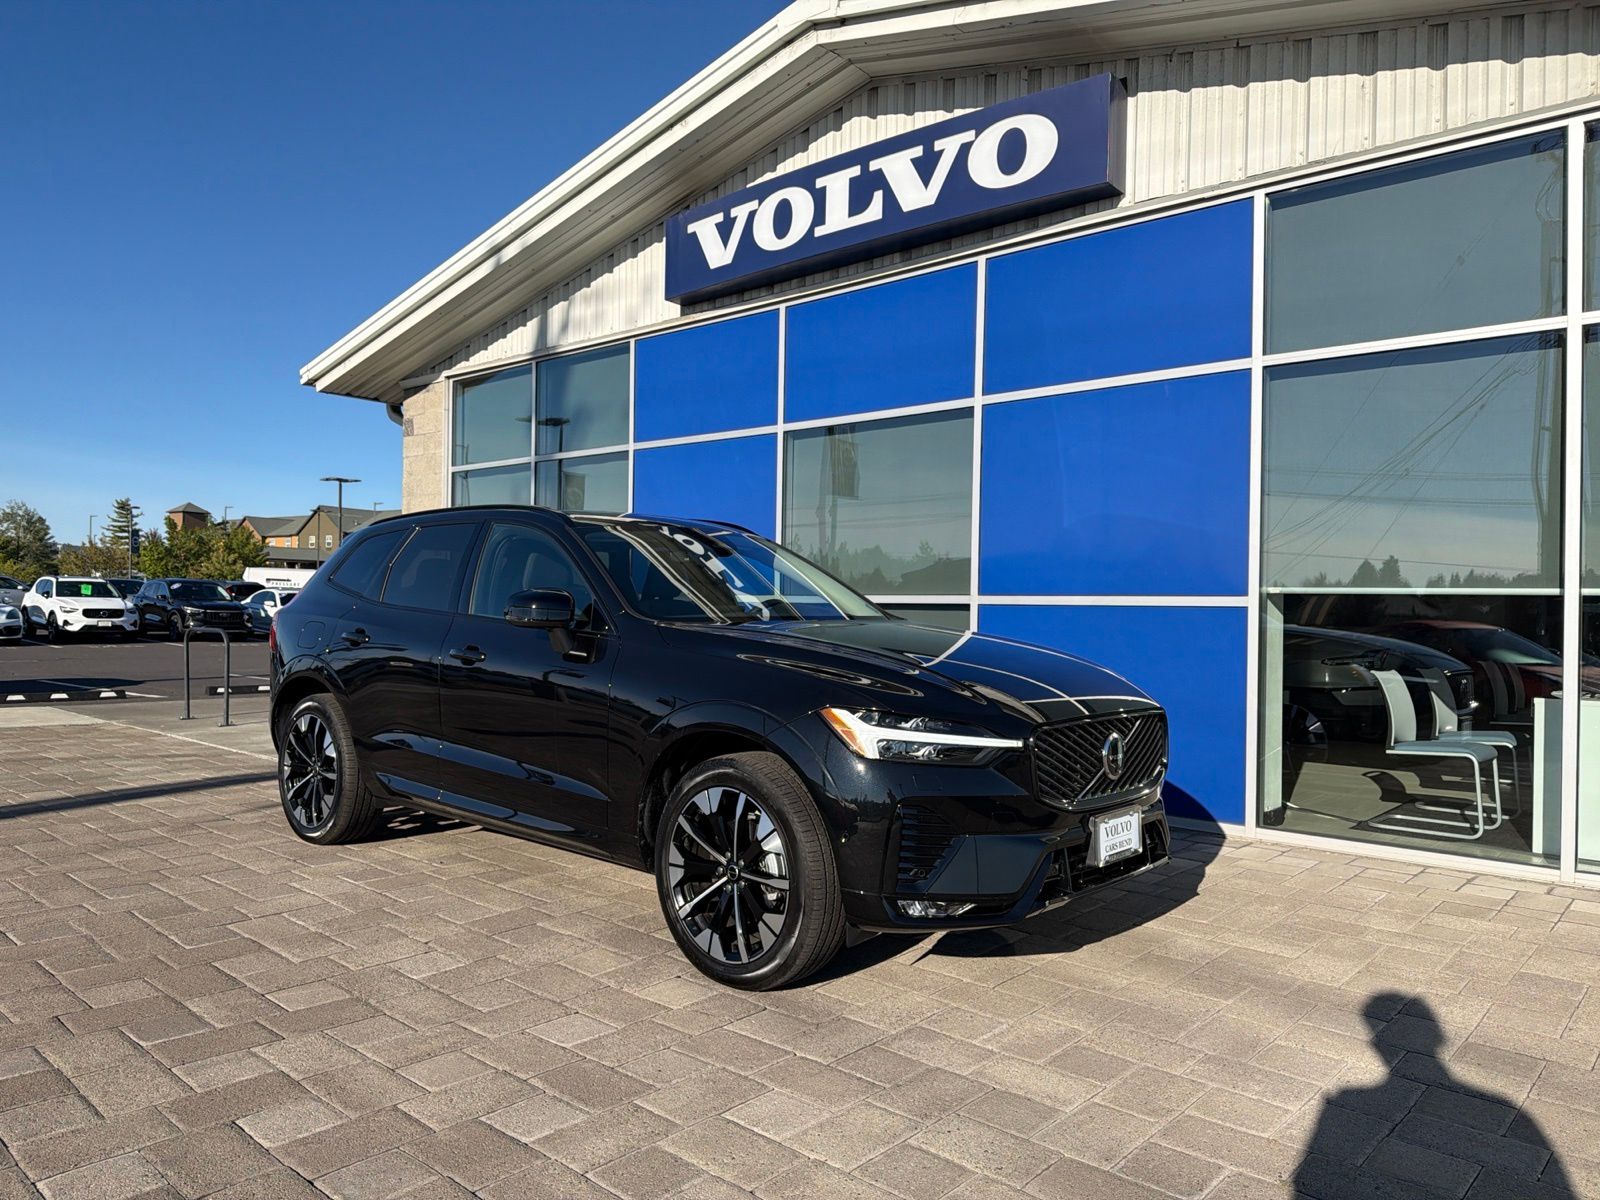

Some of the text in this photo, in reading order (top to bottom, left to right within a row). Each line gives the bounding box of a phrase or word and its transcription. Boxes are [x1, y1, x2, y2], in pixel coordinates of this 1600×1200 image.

[687, 113, 1059, 270] VOLVO
[1104, 820, 1132, 838] VOLVO
[1105, 841, 1118, 853] CARS
